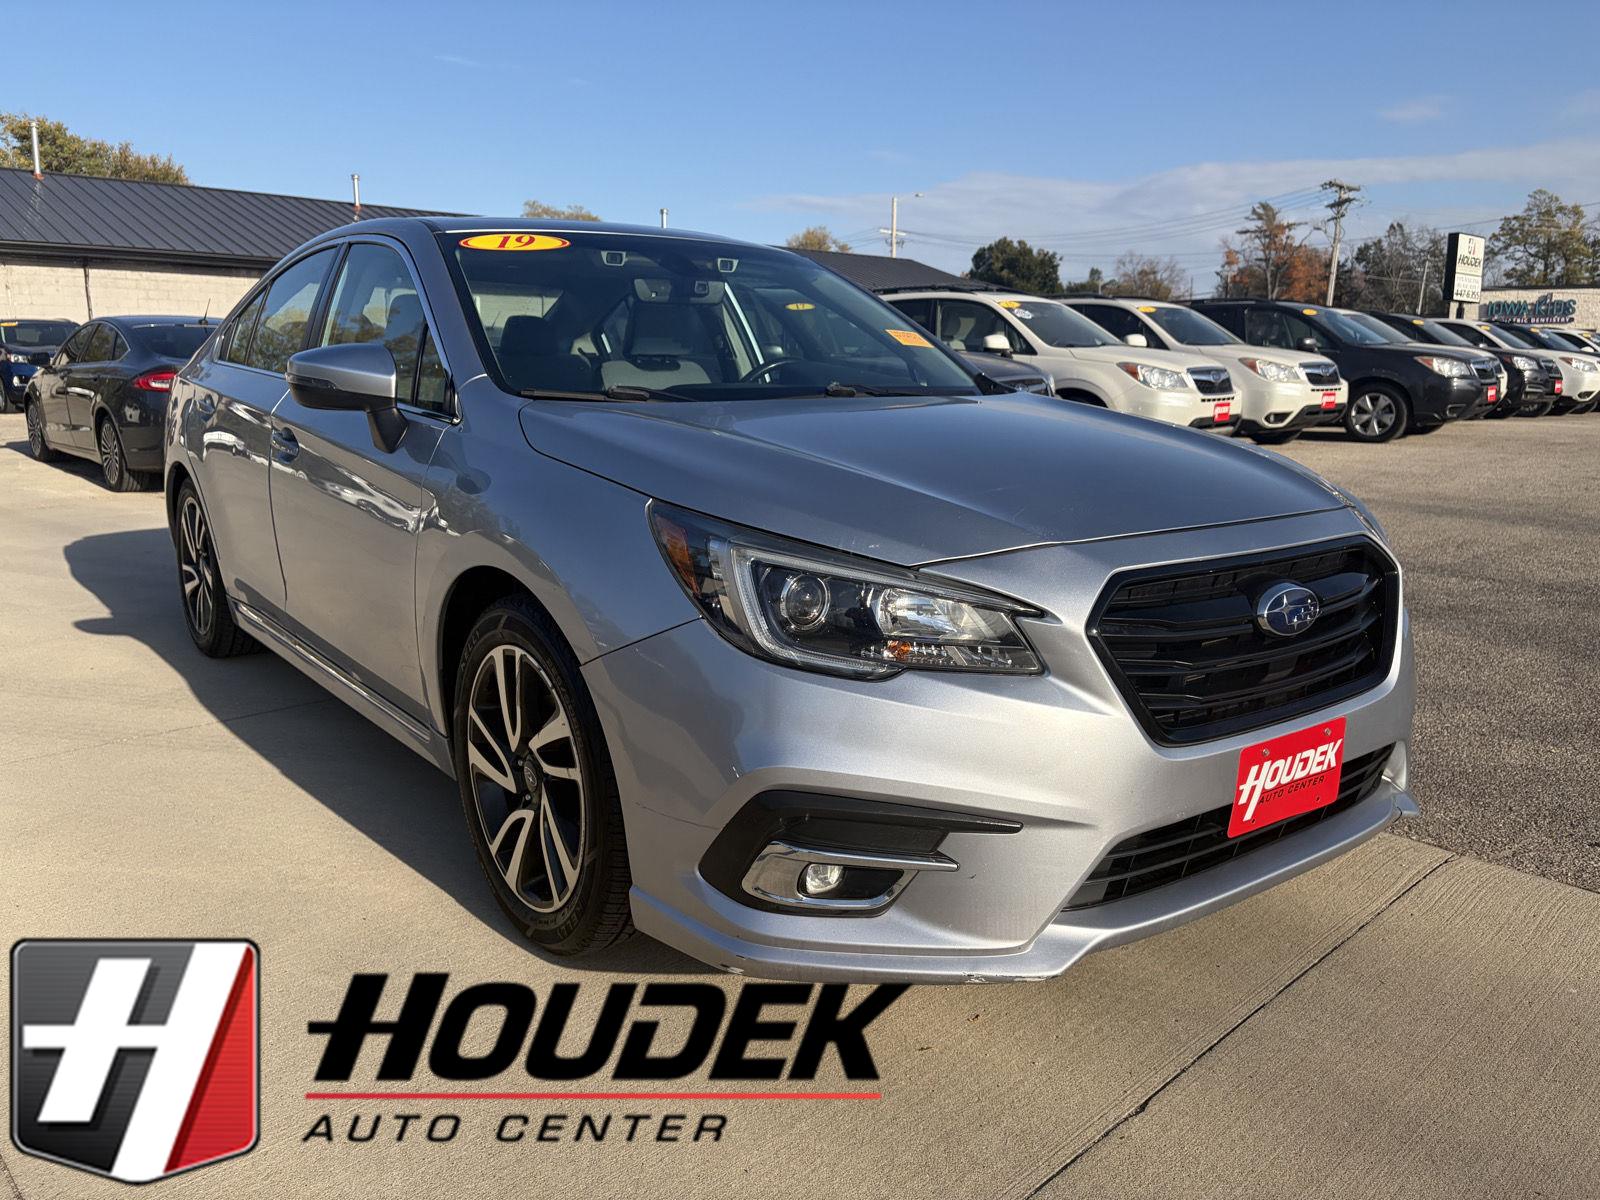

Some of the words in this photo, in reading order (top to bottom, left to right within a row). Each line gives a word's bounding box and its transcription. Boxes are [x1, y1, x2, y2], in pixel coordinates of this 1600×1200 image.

[497, 235, 536, 249] 19
[1487, 301, 1529, 316] IOWA
[1531, 315, 1570, 324] DENTISTRY
[1238, 738, 1343, 822] HOUDEK
[1259, 789, 1285, 804] AUTO
[1287, 775, 1325, 793] CENTER
